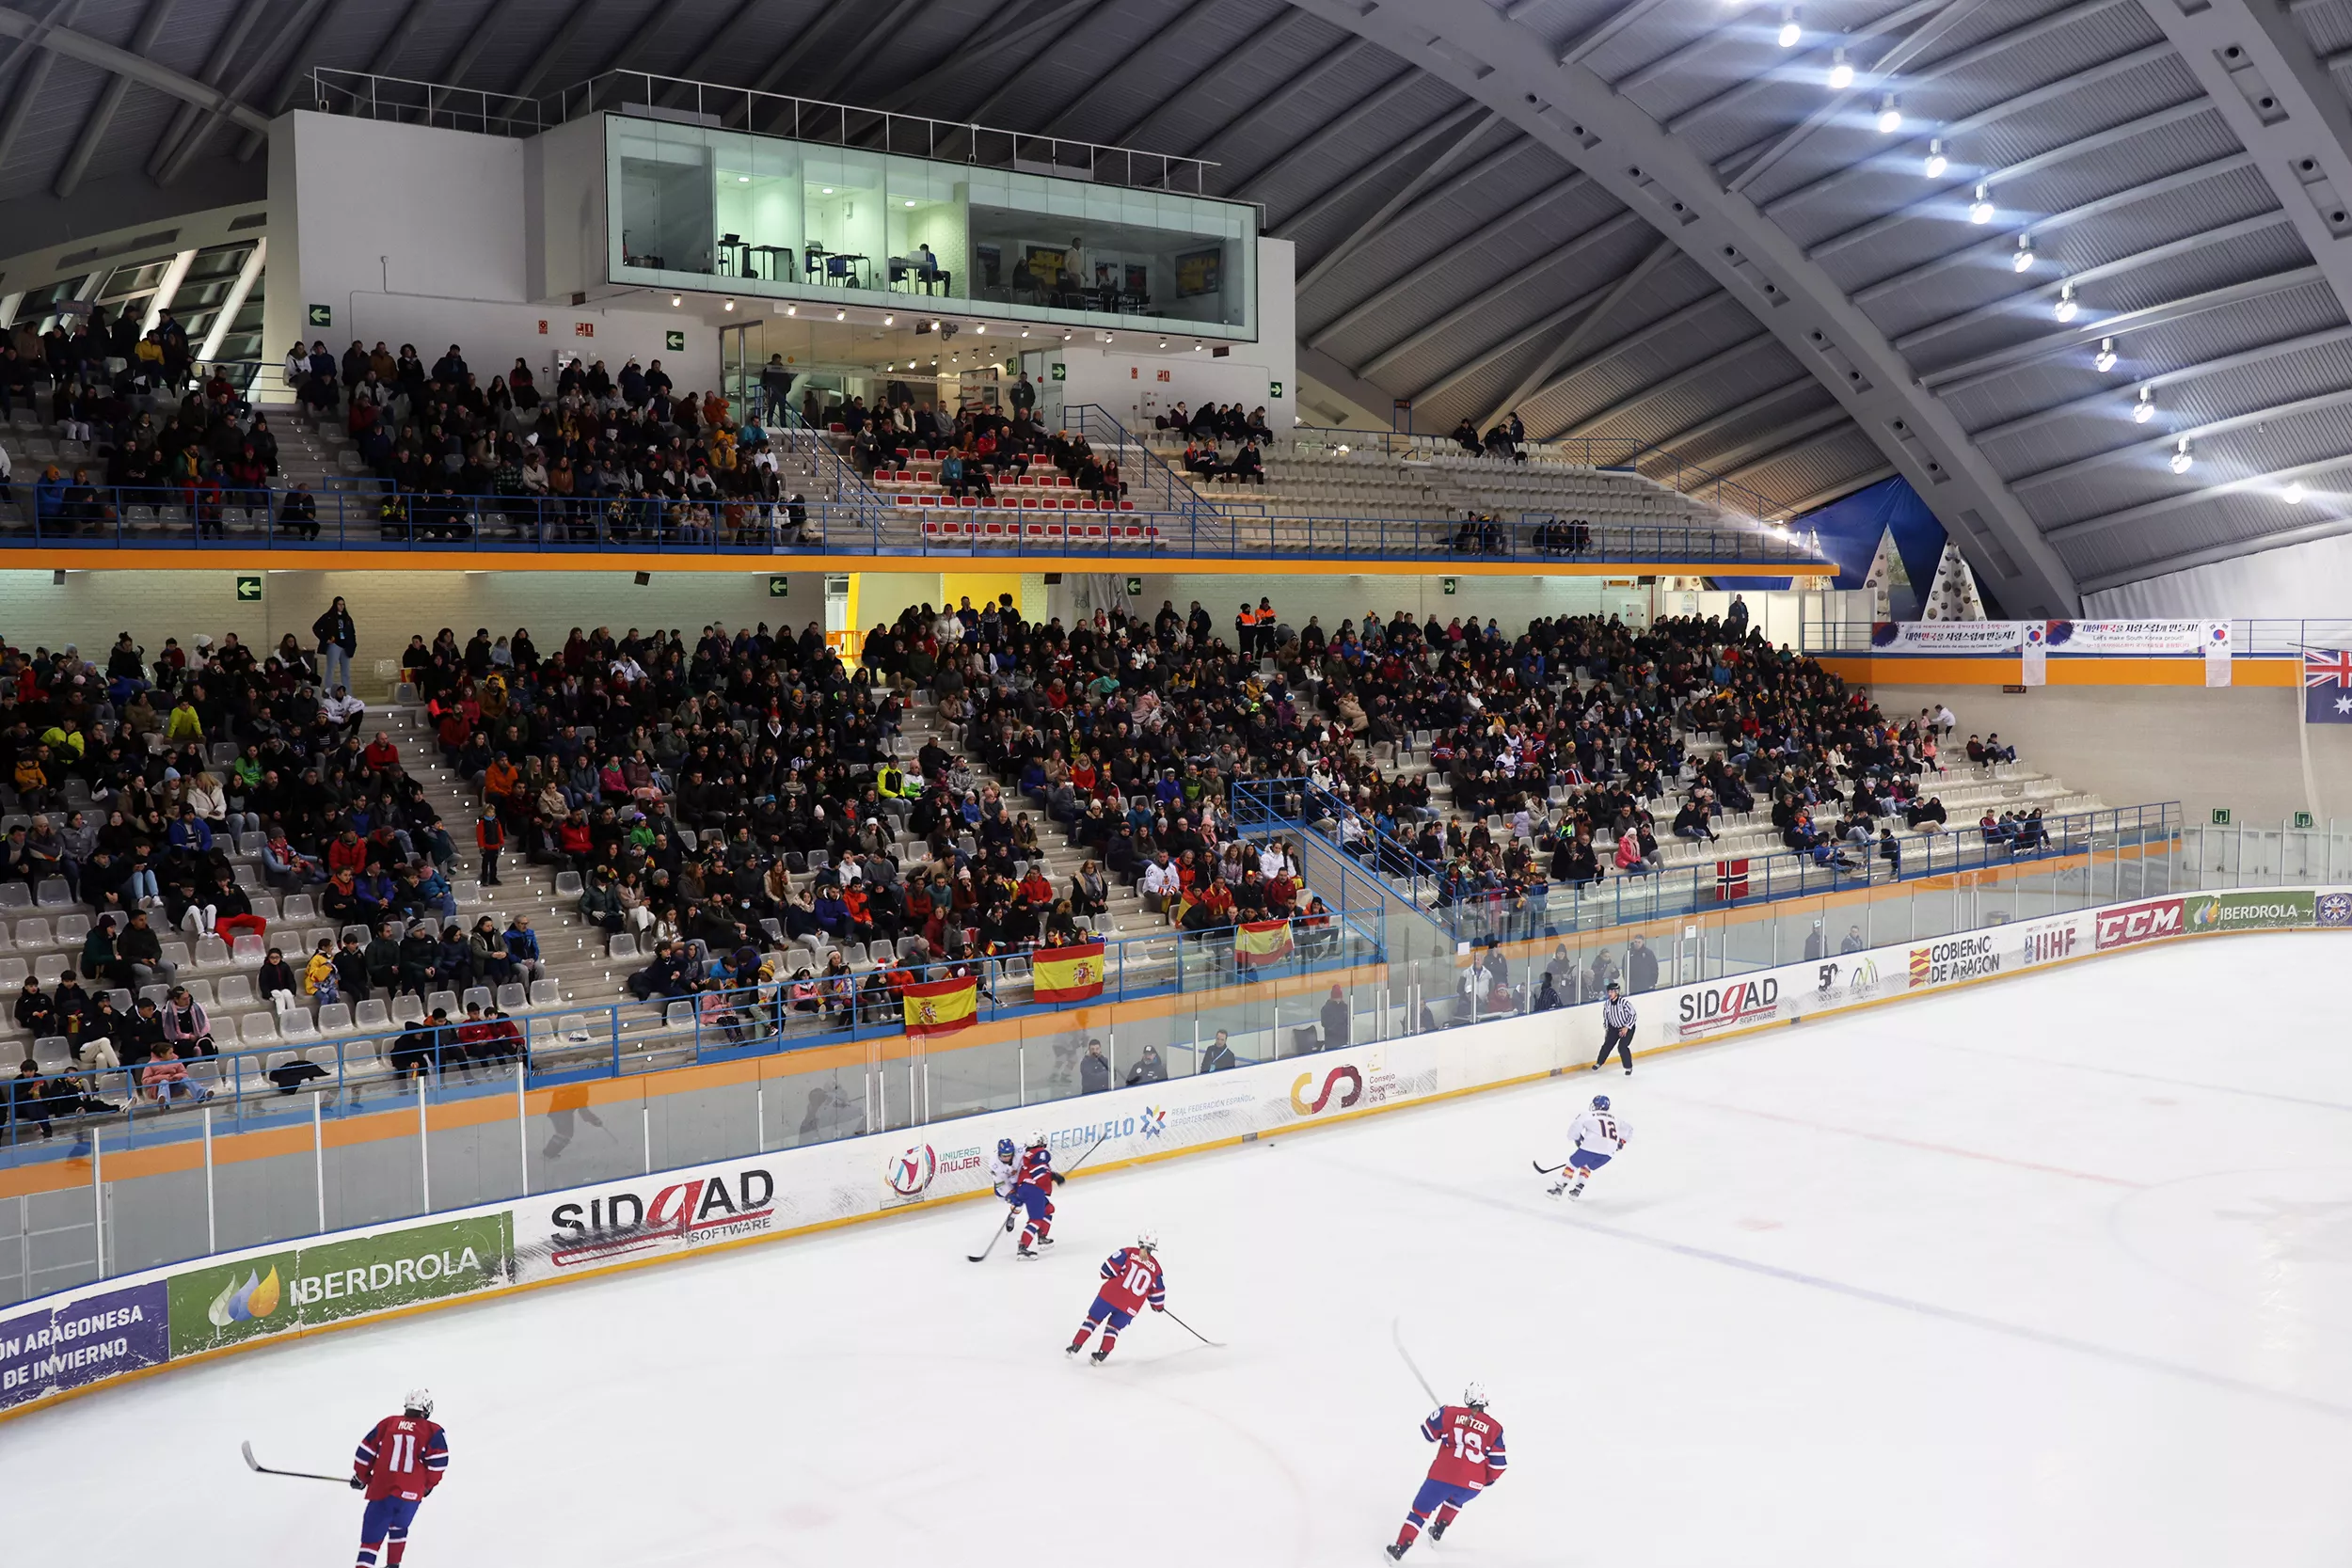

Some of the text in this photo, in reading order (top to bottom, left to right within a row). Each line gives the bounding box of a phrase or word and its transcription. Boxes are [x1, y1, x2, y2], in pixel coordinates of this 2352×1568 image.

[2098, 906, 2181, 943] CCM
[2220, 904, 2297, 921] IBERDROLA
[1931, 935, 1992, 963] GOBIERNO
[2035, 927, 2076, 961] IIHF
[1931, 965, 1947, 984] DE
[1740, 1010, 1776, 1025] SOFTWARE
[1369, 1073, 1396, 1085] Consejo
[1171, 1108, 1187, 1117] REAL
[1049, 1117, 1135, 1151] FEDHIELO
[1597, 1118, 1617, 1142] 12
[939, 1147, 981, 1162] UNIVERSO
[940, 1156, 981, 1175] MUJER
[691, 1217, 771, 1243] SOFTWARE
[289, 1246, 482, 1307] IBERDROLA
[1122, 1261, 1152, 1296] 10
[24, 1305, 144, 1354] ARAGONESA
[3, 1338, 127, 1390] DE INVIERNO
[389, 1433, 416, 1473] 11
